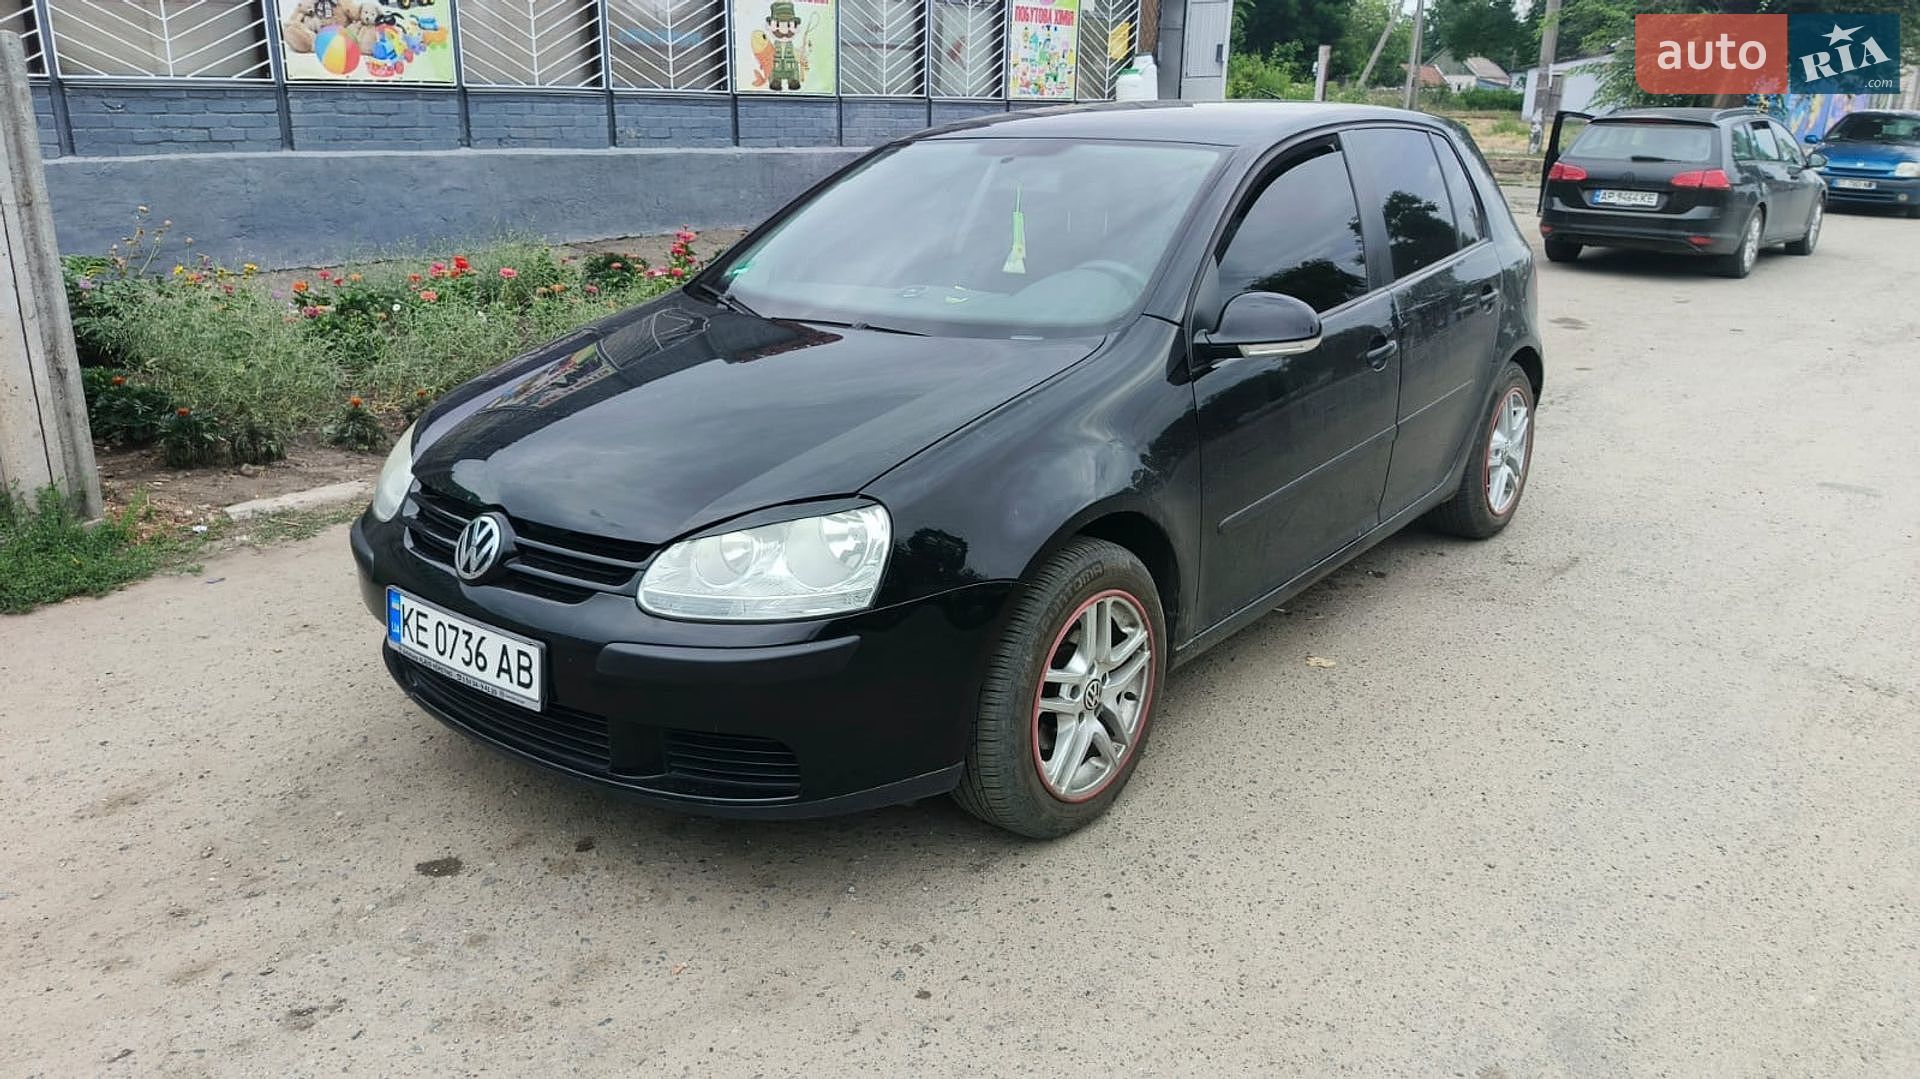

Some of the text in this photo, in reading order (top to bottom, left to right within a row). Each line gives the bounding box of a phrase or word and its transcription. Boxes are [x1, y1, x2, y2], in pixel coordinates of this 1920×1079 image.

[401, 603, 429, 649] KE
[435, 620, 488, 672] 0736
[496, 643, 534, 690] AB
